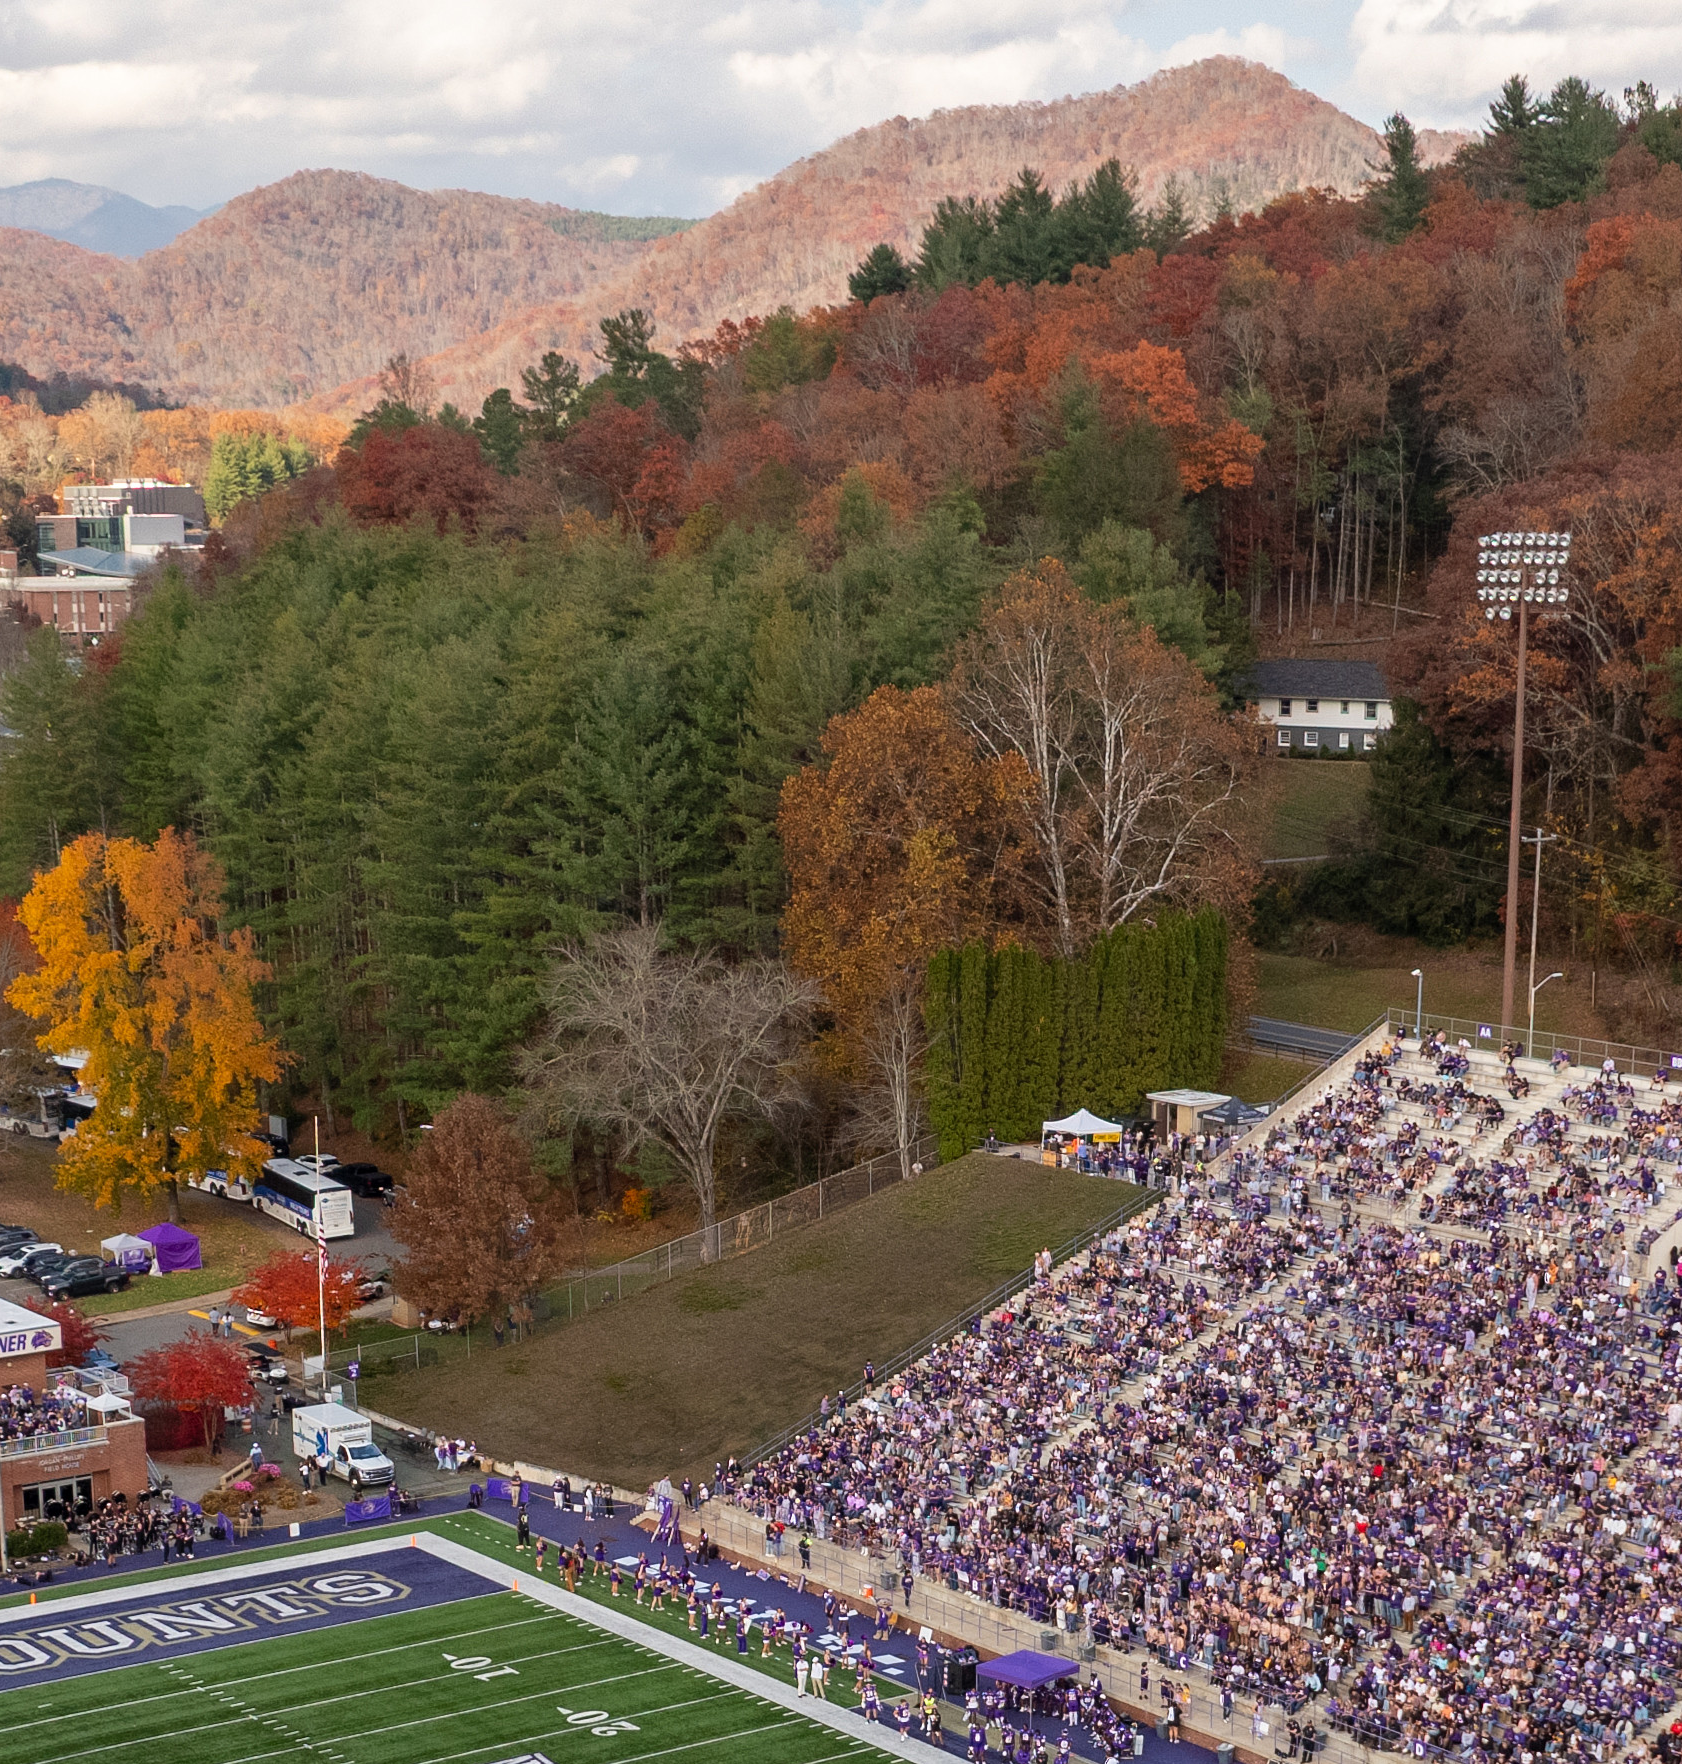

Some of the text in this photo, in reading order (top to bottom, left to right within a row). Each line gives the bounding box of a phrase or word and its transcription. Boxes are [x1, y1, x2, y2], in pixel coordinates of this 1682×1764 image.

[450, 1656, 520, 1682] 10
[1179, 1655, 1187, 1669] C
[567, 1709, 640, 1736] 20
[1414, 1742, 1425, 1757] D
